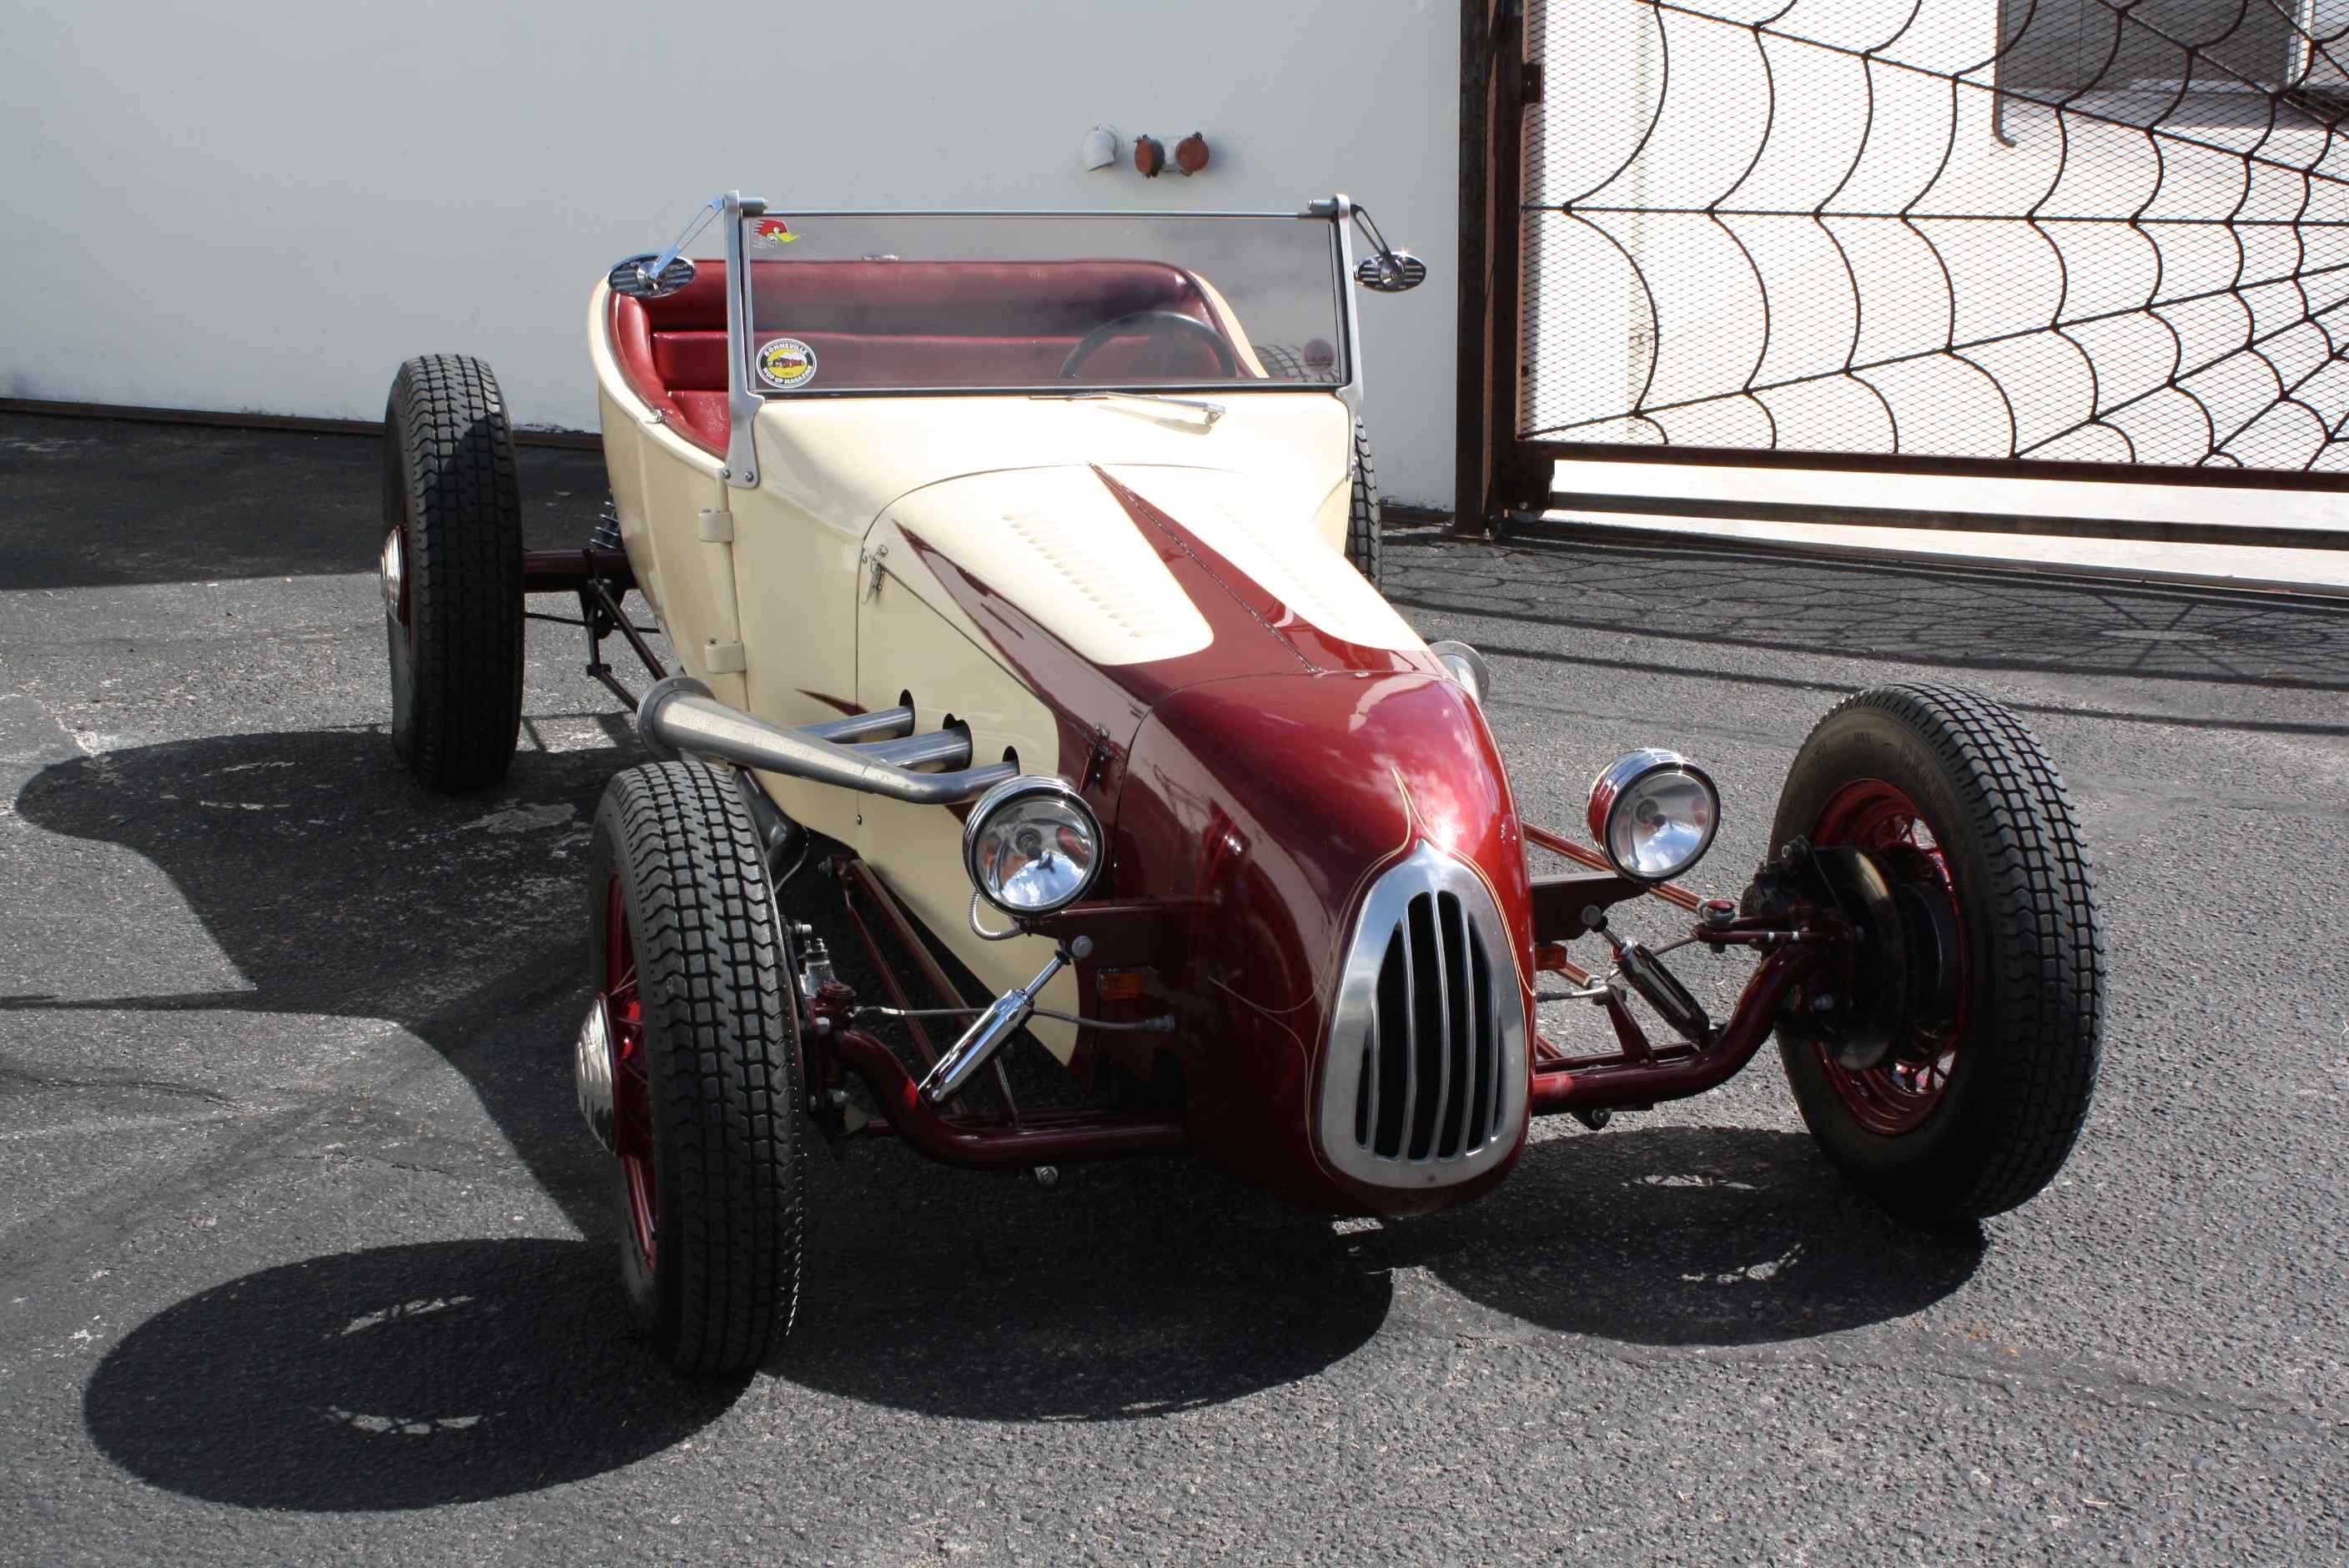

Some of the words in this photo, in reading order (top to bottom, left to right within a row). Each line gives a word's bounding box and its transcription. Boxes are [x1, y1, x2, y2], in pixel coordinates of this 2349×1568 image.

[764, 342, 807, 356] BONNEVILLE
[762, 367, 775, 380] HOP
[784, 365, 812, 384] MAGAZINE
